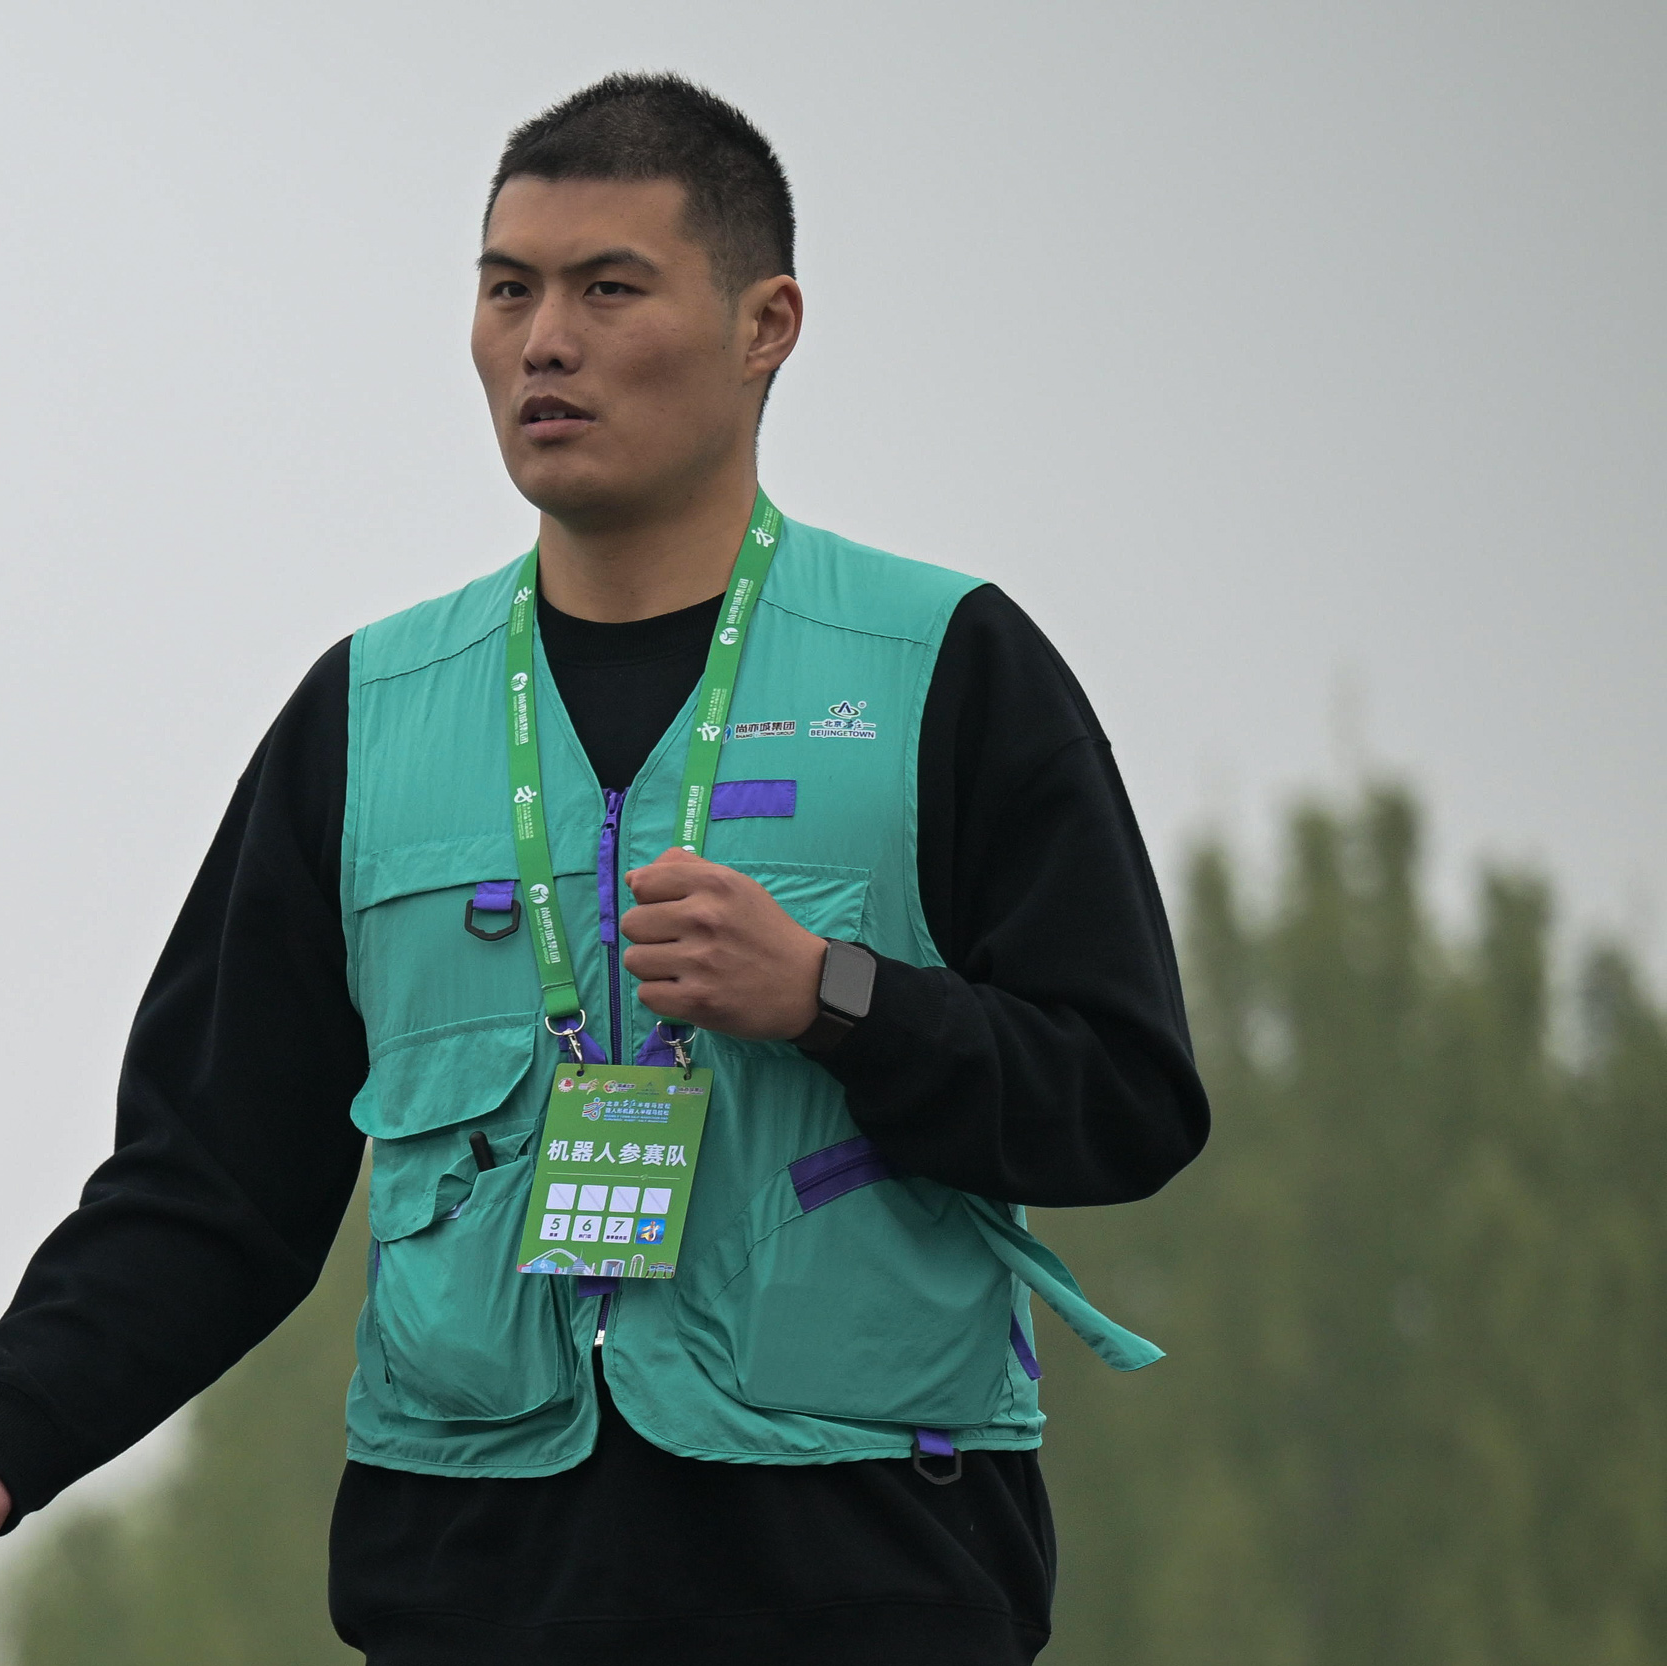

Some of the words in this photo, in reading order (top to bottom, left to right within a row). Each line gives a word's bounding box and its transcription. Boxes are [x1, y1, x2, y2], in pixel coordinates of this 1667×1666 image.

[736, 721, 795, 733] 尚亦城集团
[547, 1139, 687, 1167] 机器人参赛队
[550, 1218, 561, 1230] 5
[582, 1219, 592, 1232] 6
[613, 1220, 625, 1233] 7
